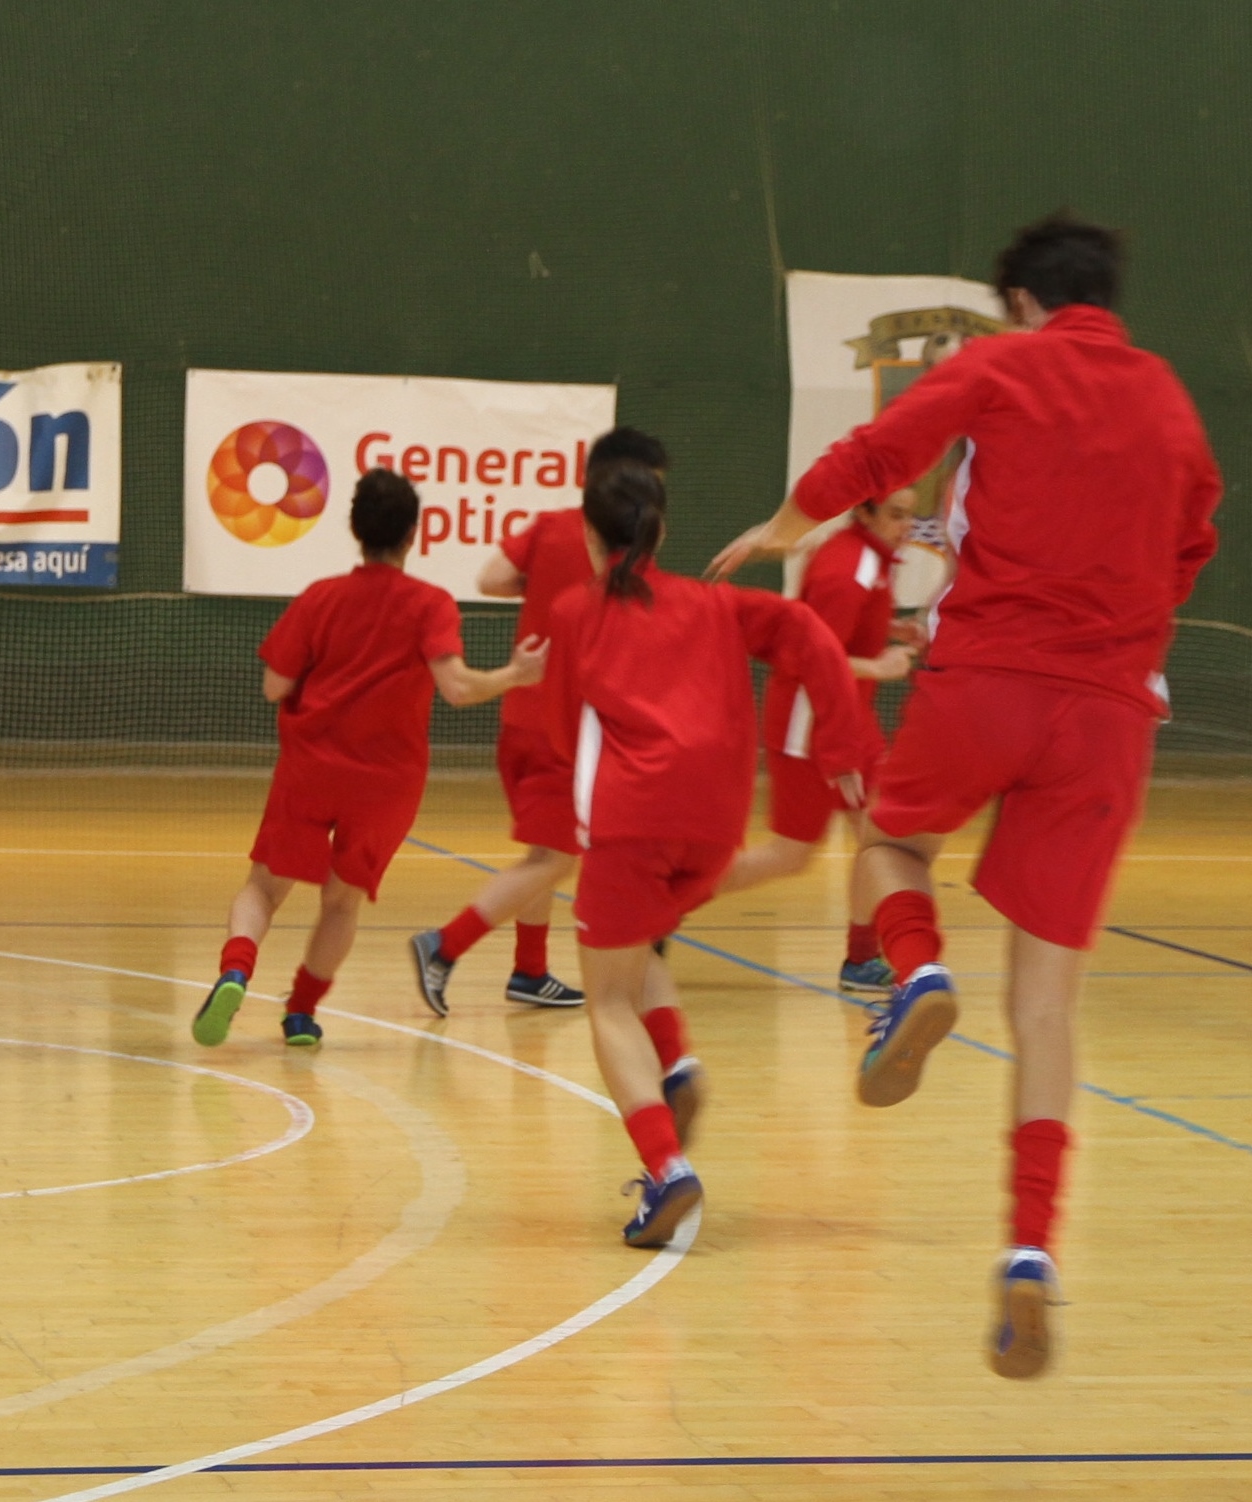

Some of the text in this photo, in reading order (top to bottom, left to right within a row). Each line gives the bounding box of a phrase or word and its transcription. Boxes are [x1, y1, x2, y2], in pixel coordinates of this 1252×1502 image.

[355, 432, 586, 489] General
[420, 494, 530, 556] ptic
[32, 544, 90, 579] aquí
